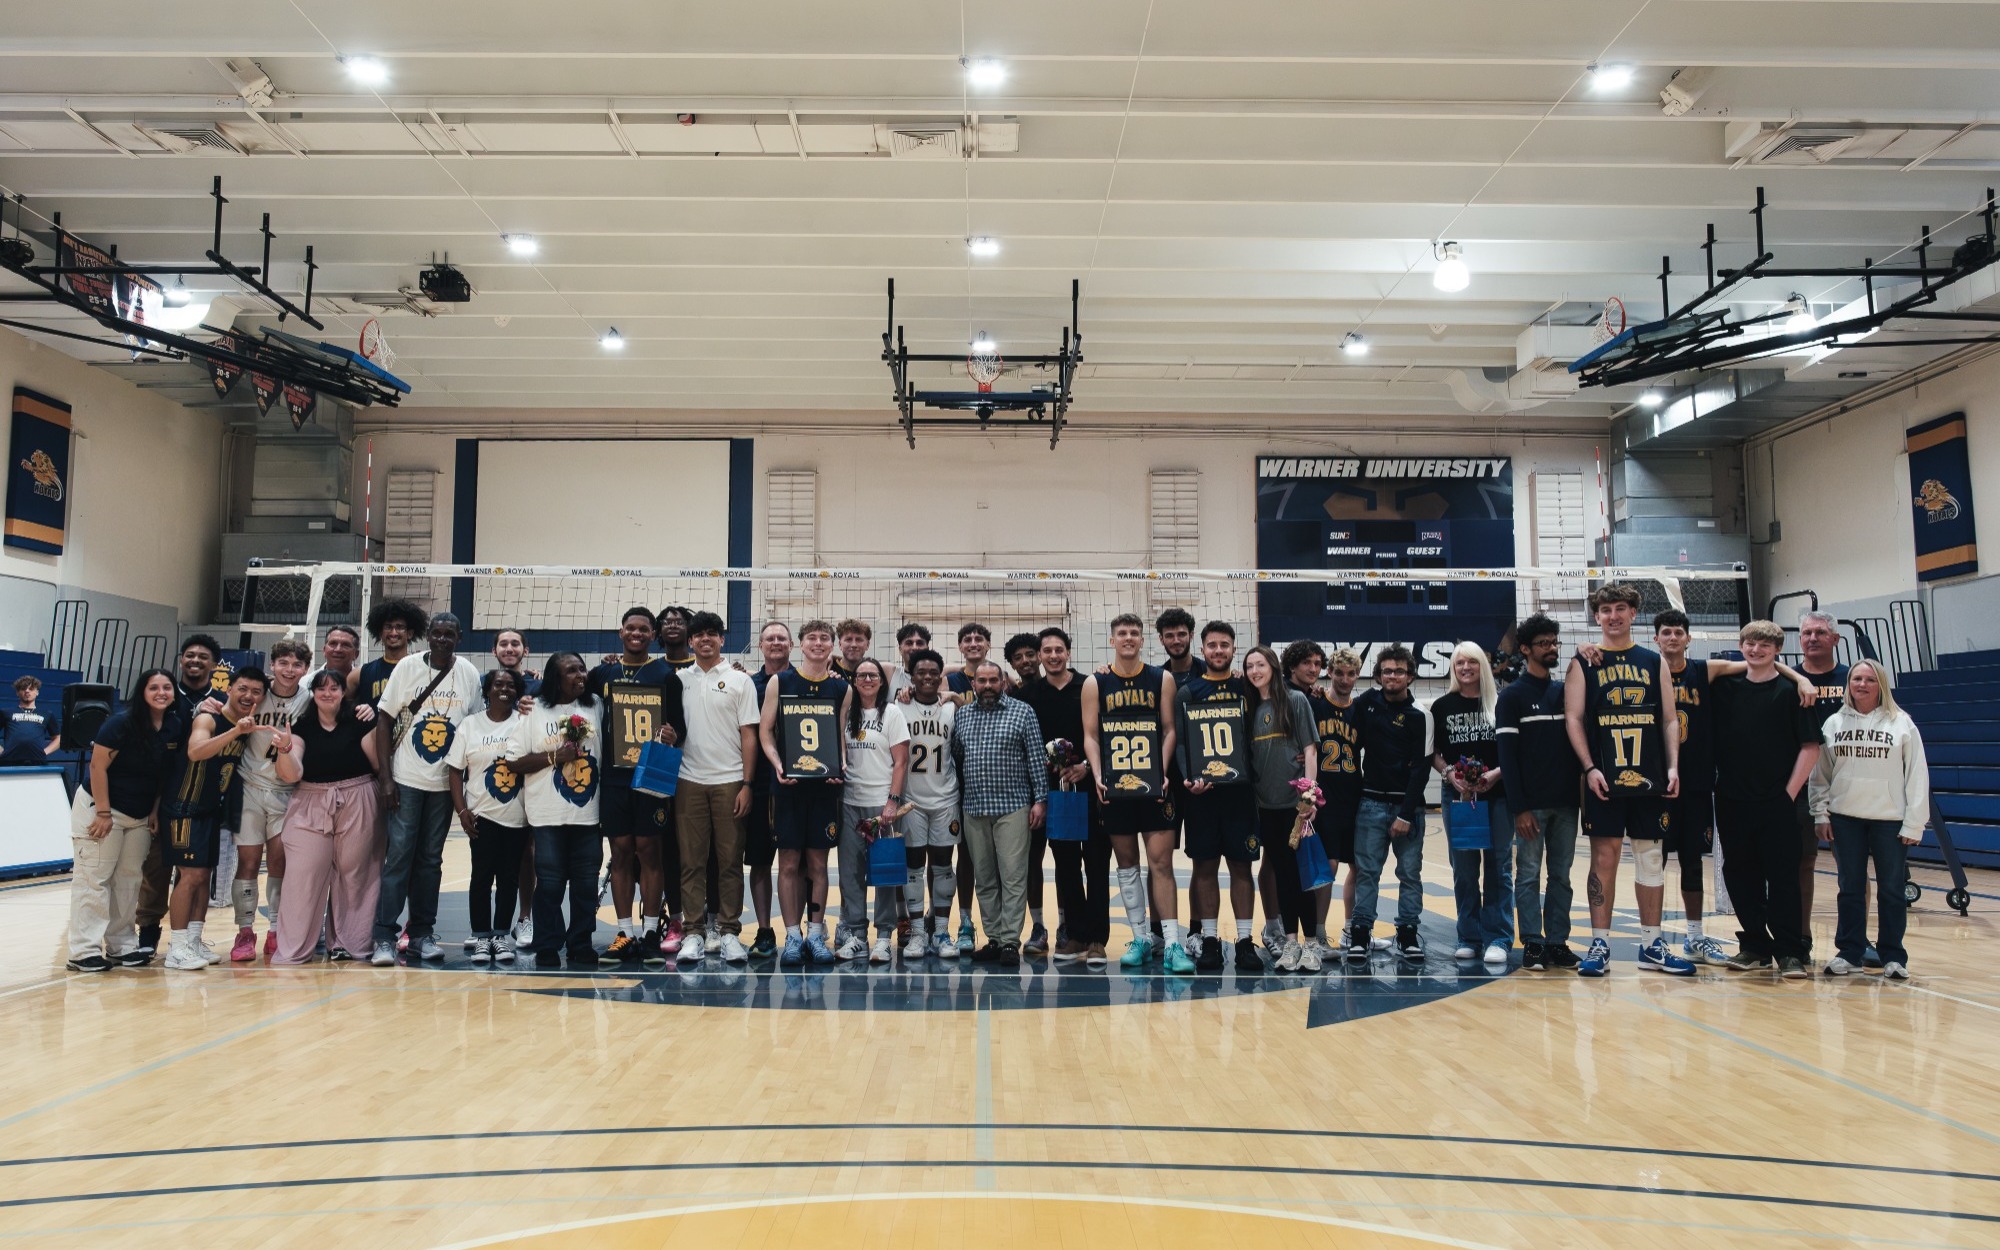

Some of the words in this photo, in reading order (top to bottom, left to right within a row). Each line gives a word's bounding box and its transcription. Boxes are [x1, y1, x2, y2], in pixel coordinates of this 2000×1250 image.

[1259, 459, 1361, 478] WARNER
[1365, 459, 1507, 478] UNIVERSITY
[1327, 547, 1371, 555] WARNER
[1406, 547, 1442, 555] GUEST
[357, 565, 385, 573] WNER
[464, 567, 492, 575] WARNER
[571, 568, 600, 576] WARNER
[616, 569, 642, 577] ROYALS
[1597, 664, 1651, 688] ROYALS
[612, 693, 662, 706] WARNER
[1106, 688, 1156, 713] ROYALS
[1606, 687, 1646, 706] 17
[783, 704, 834, 716] WARNER
[1187, 708, 1242, 720] WARNER
[623, 708, 652, 743] 18
[1102, 721, 1156, 732] WARNER
[1598, 714, 1655, 726] WARNER
[800, 718, 820, 752] 9
[1200, 722, 1234, 757] 10
[1319, 718, 1358, 744] ROYALS
[1448, 732, 1470, 744] CLASS
[1470, 731, 1480, 742] OF
[1834, 729, 1894, 746] WARNER
[1110, 736, 1152, 770] 22
[1610, 728, 1643, 767] 17
[911, 744, 943, 773] 21
[1320, 740, 1357, 774] 23
